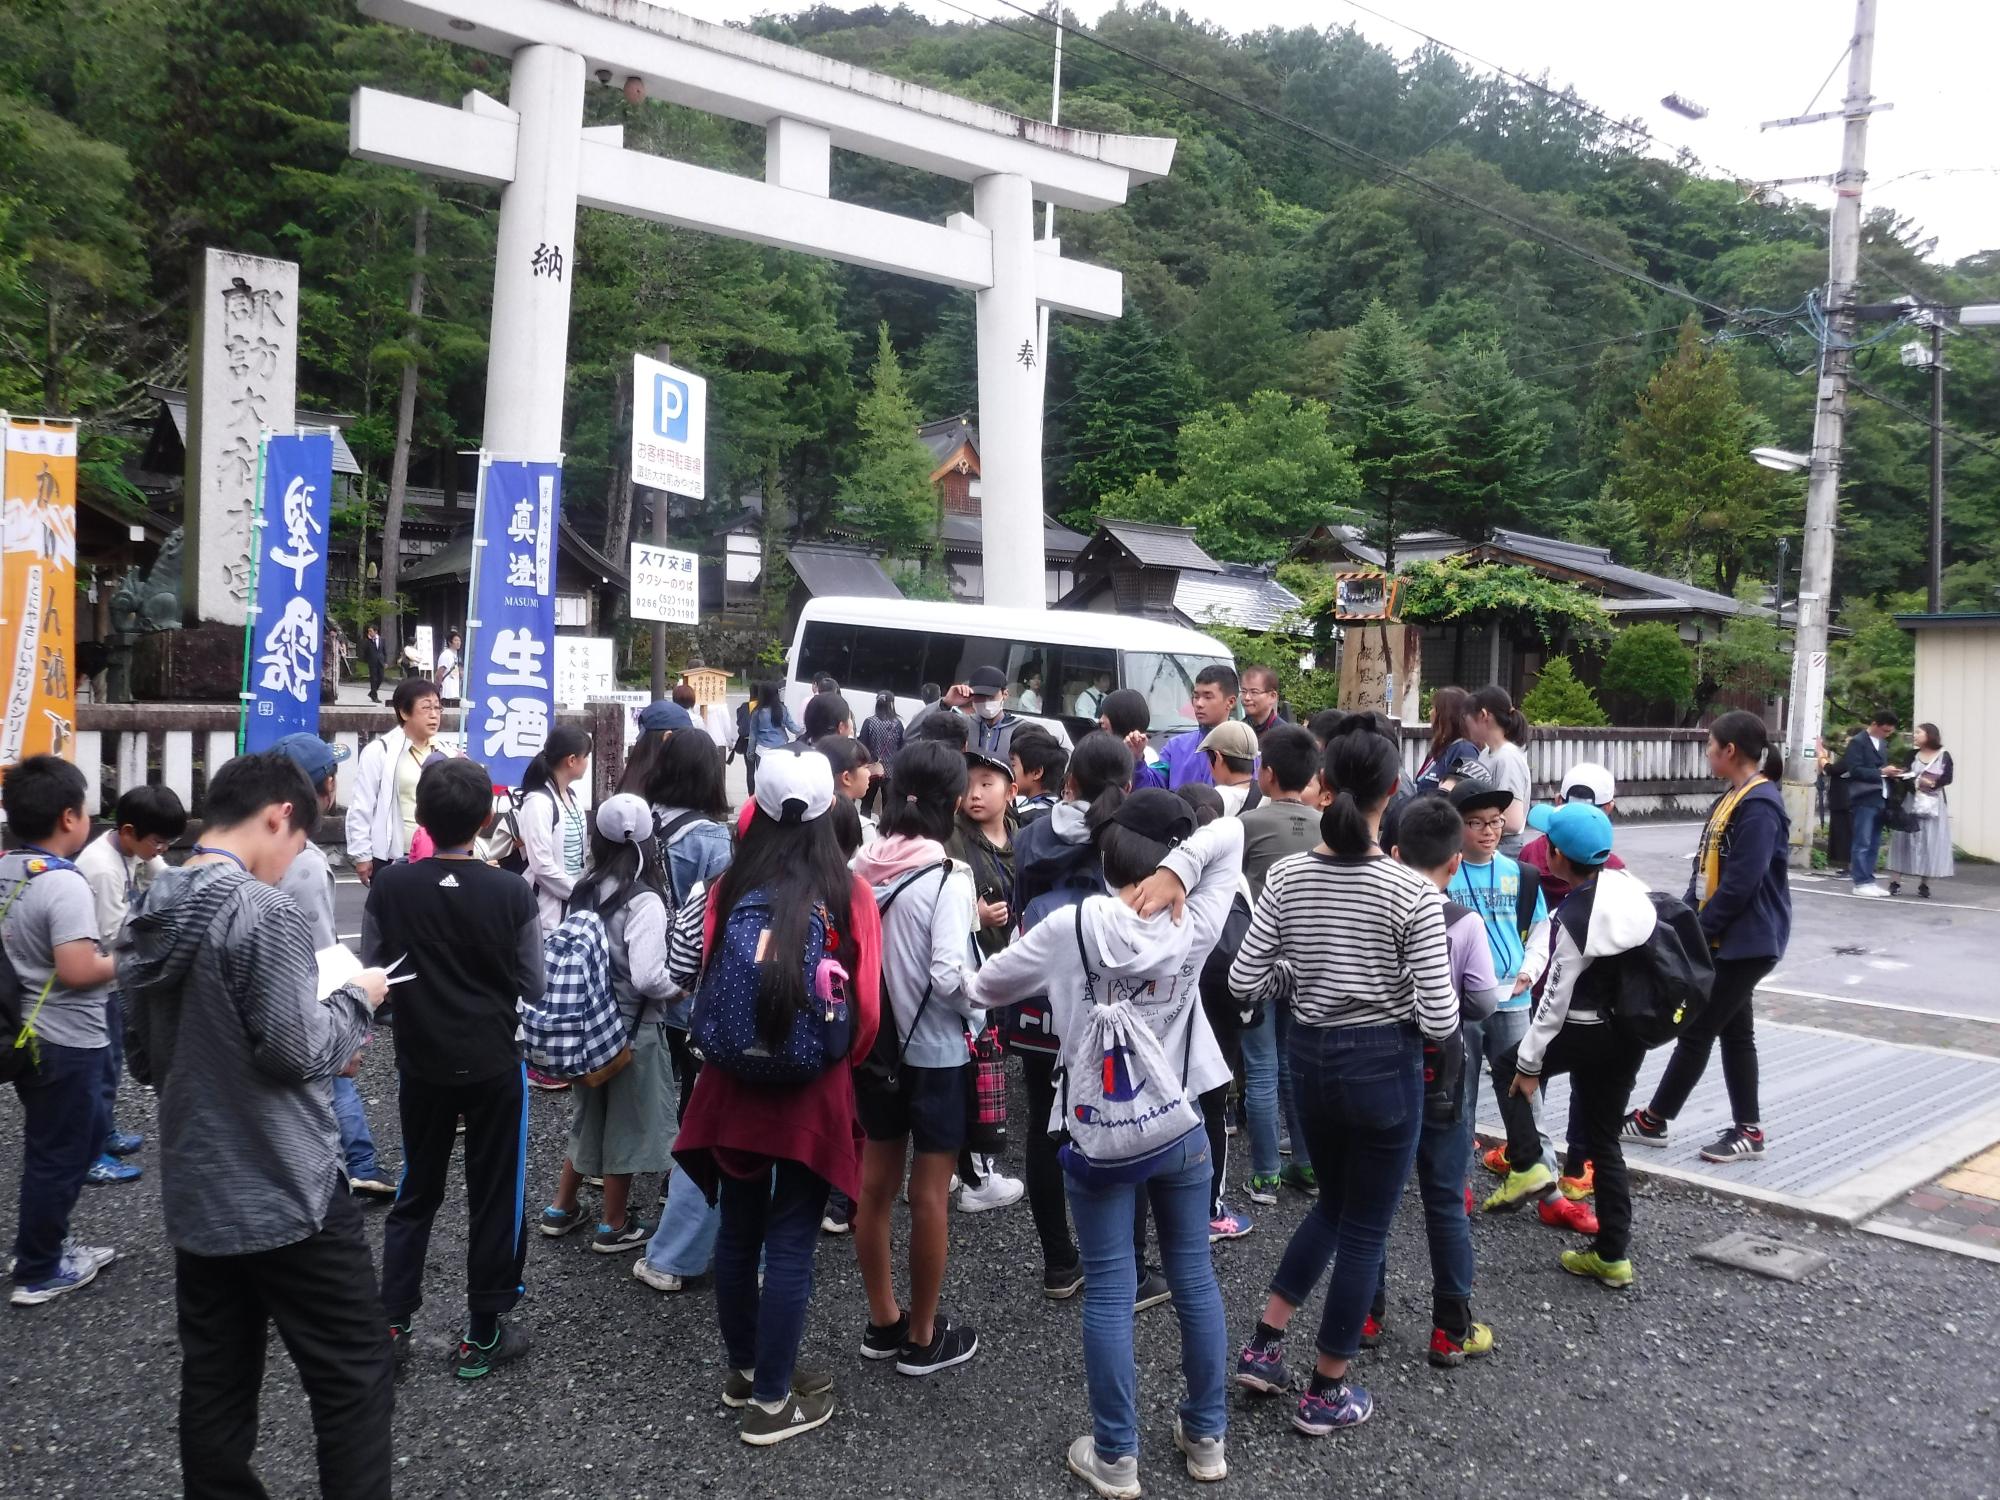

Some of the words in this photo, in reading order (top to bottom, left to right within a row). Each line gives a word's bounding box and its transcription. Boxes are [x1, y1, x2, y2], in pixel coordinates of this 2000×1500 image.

[531, 243, 563, 282] 納
[1016, 339, 1036, 372] 奉
[661, 381, 683, 433] P
[637, 442, 701, 475] お客様用駐車場
[507, 498, 537, 587] 真澄
[639, 550, 693, 573] スワ交通
[637, 573, 694, 591] タクシーのりば
[505, 597, 539, 608] MASUMI
[484, 627, 549, 758] 生酒
[1075, 1098, 1181, 1133] Champion
